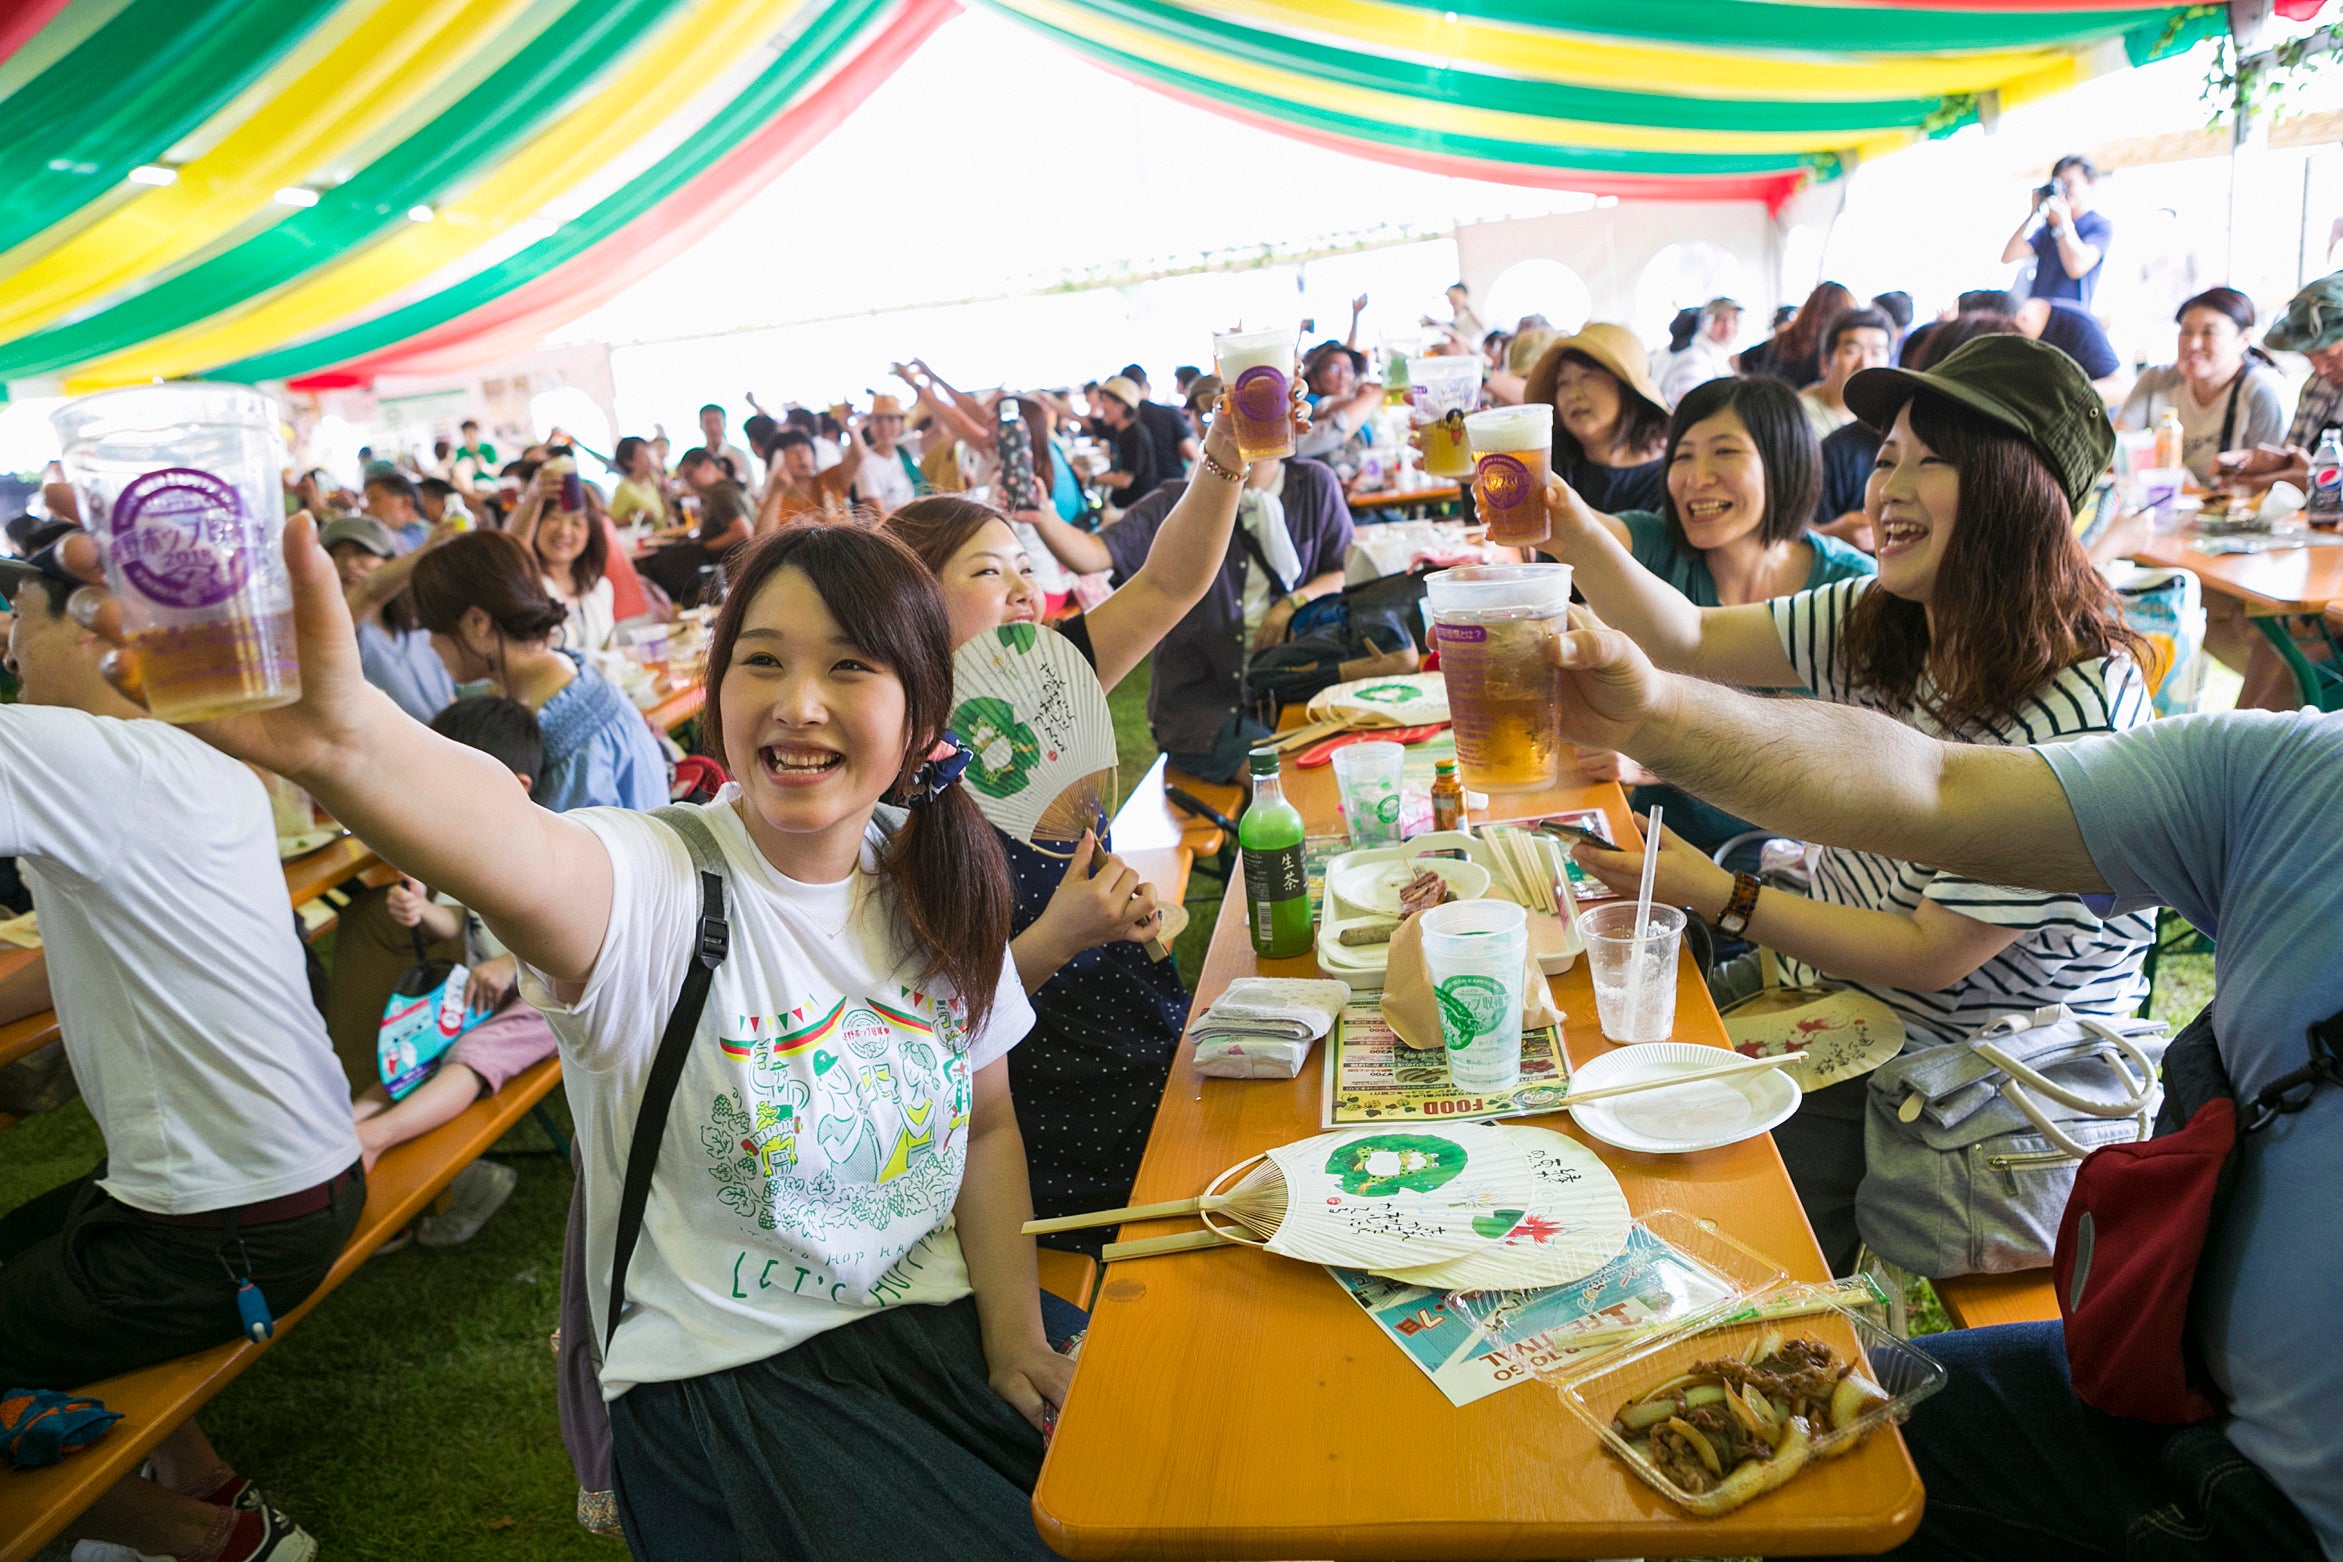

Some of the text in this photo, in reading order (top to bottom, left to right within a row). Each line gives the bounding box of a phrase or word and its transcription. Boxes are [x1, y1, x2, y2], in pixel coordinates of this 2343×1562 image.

[1281, 852, 1300, 891] 生茶
[1423, 1098, 1484, 1115] FOOD
[825, 1250, 865, 1266] HOP
[1478, 1313, 1608, 1368] FETIVAL
[1493, 1364, 1526, 1382] GO
